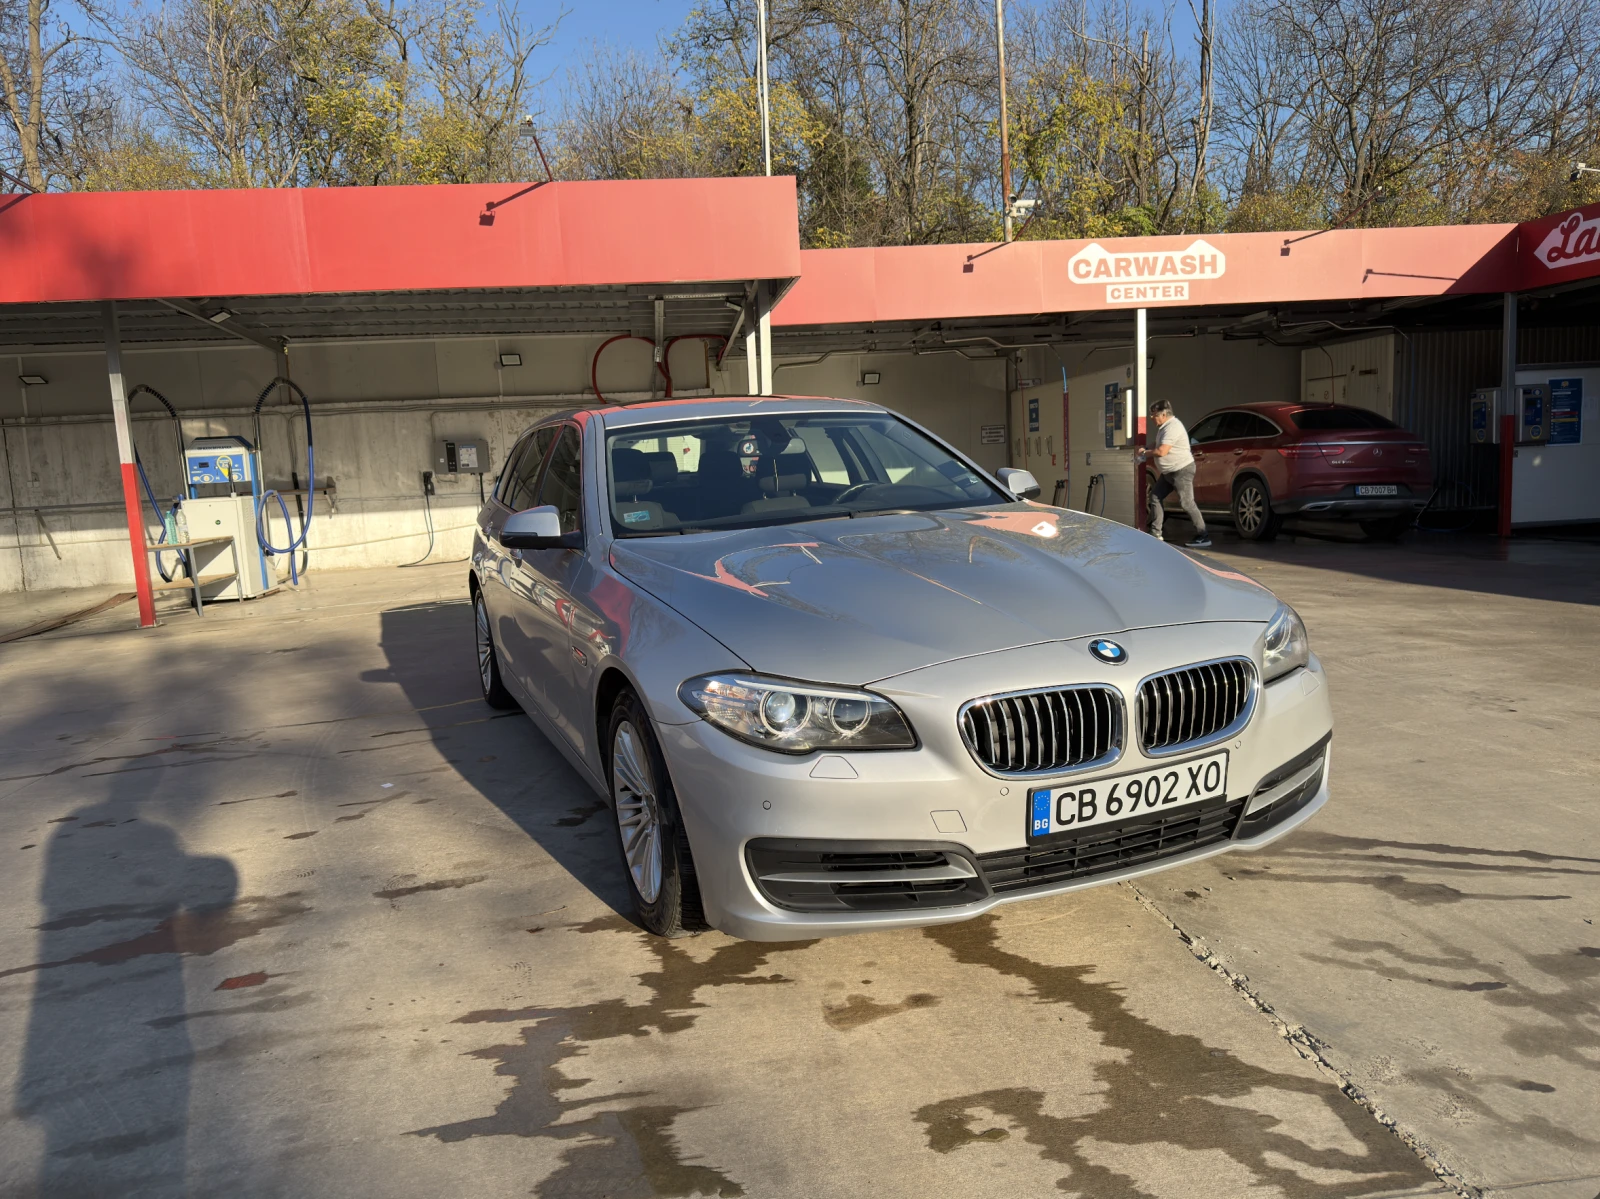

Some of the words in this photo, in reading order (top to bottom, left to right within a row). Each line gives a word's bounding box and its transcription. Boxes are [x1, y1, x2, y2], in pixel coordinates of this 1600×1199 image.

[1546, 215, 1600, 263] La
[1073, 254, 1217, 279] CARWASH
[1110, 285, 1185, 300] CENTER
[1360, 486, 1369, 495] CB
[1370, 486, 1385, 494] 7007
[1055, 788, 1097, 826] CB
[1105, 771, 1179, 816] 6902
[1185, 760, 1221, 799] XO
[1034, 818, 1049, 831] BG
